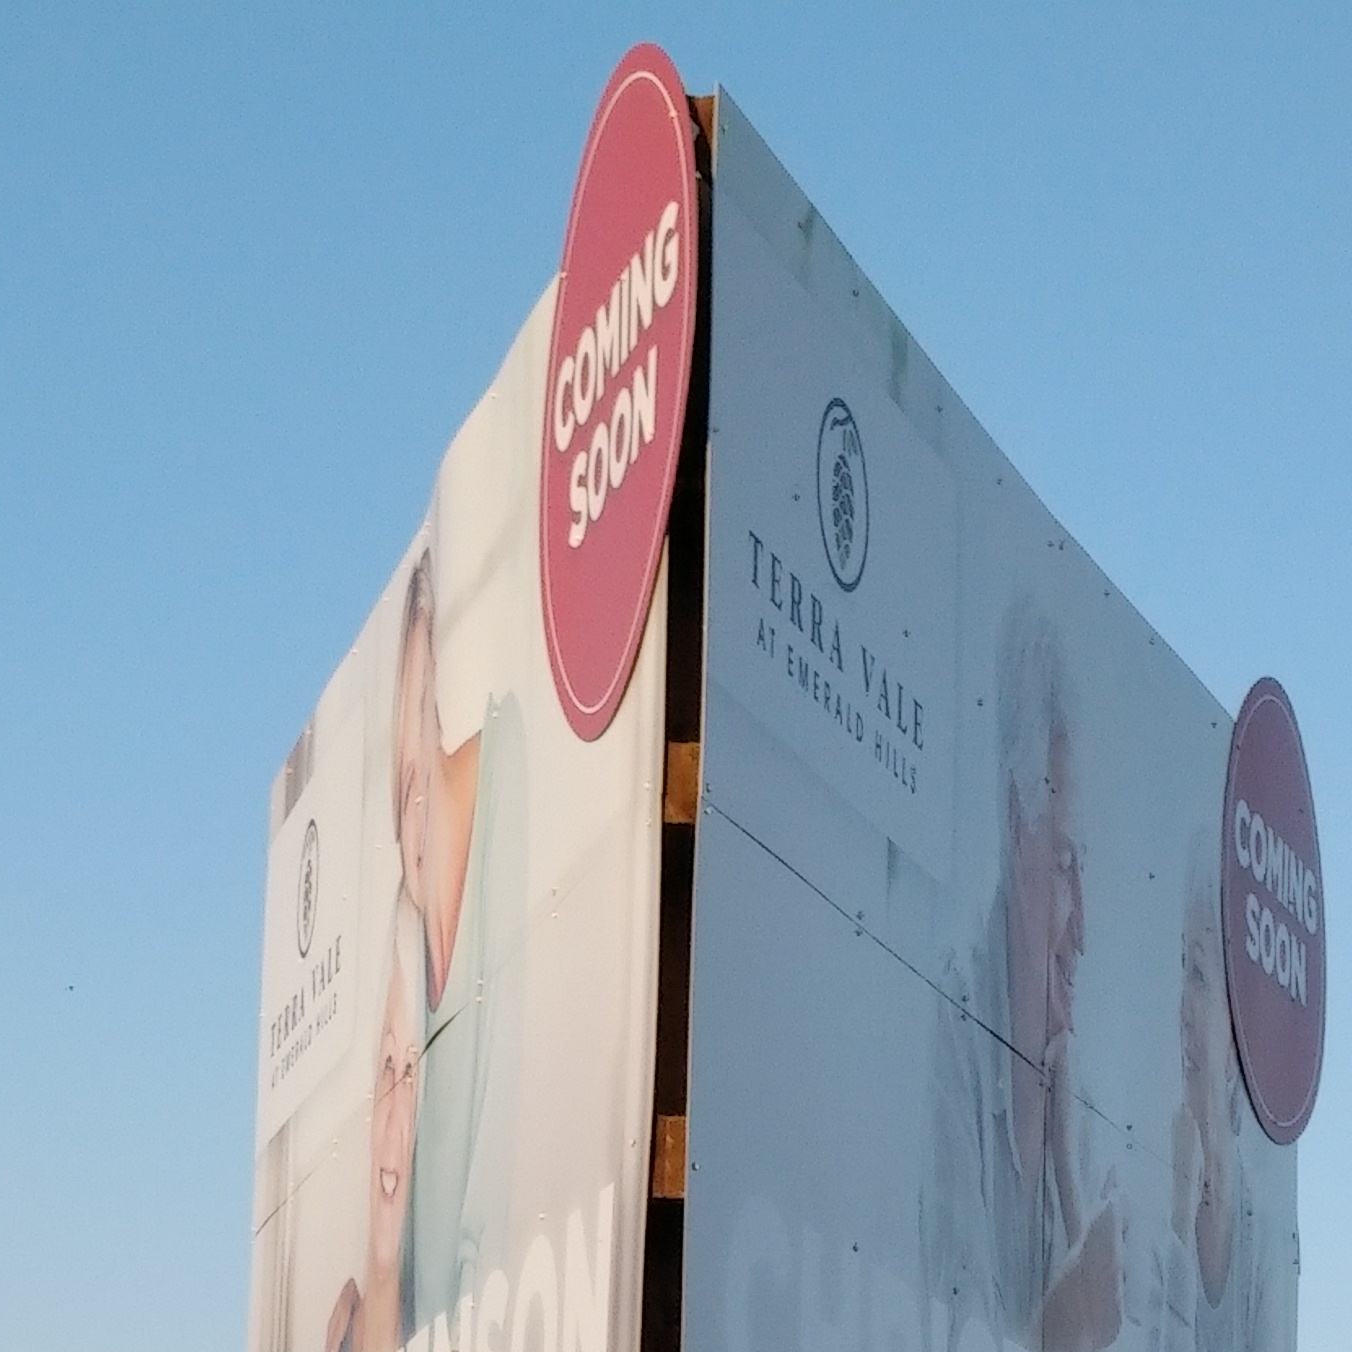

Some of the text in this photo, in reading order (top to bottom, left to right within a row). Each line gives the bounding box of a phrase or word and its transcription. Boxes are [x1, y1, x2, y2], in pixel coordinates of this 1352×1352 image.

[554, 201, 680, 452] COMING
[568, 345, 658, 549] SOON
[749, 530, 924, 751] TERRA VALE
[756, 617, 916, 795] AT EMERALD HILLS
[1234, 799, 1318, 935] COMING
[1246, 893, 1308, 1007] SOON
[271, 986, 306, 1057] TERRA
